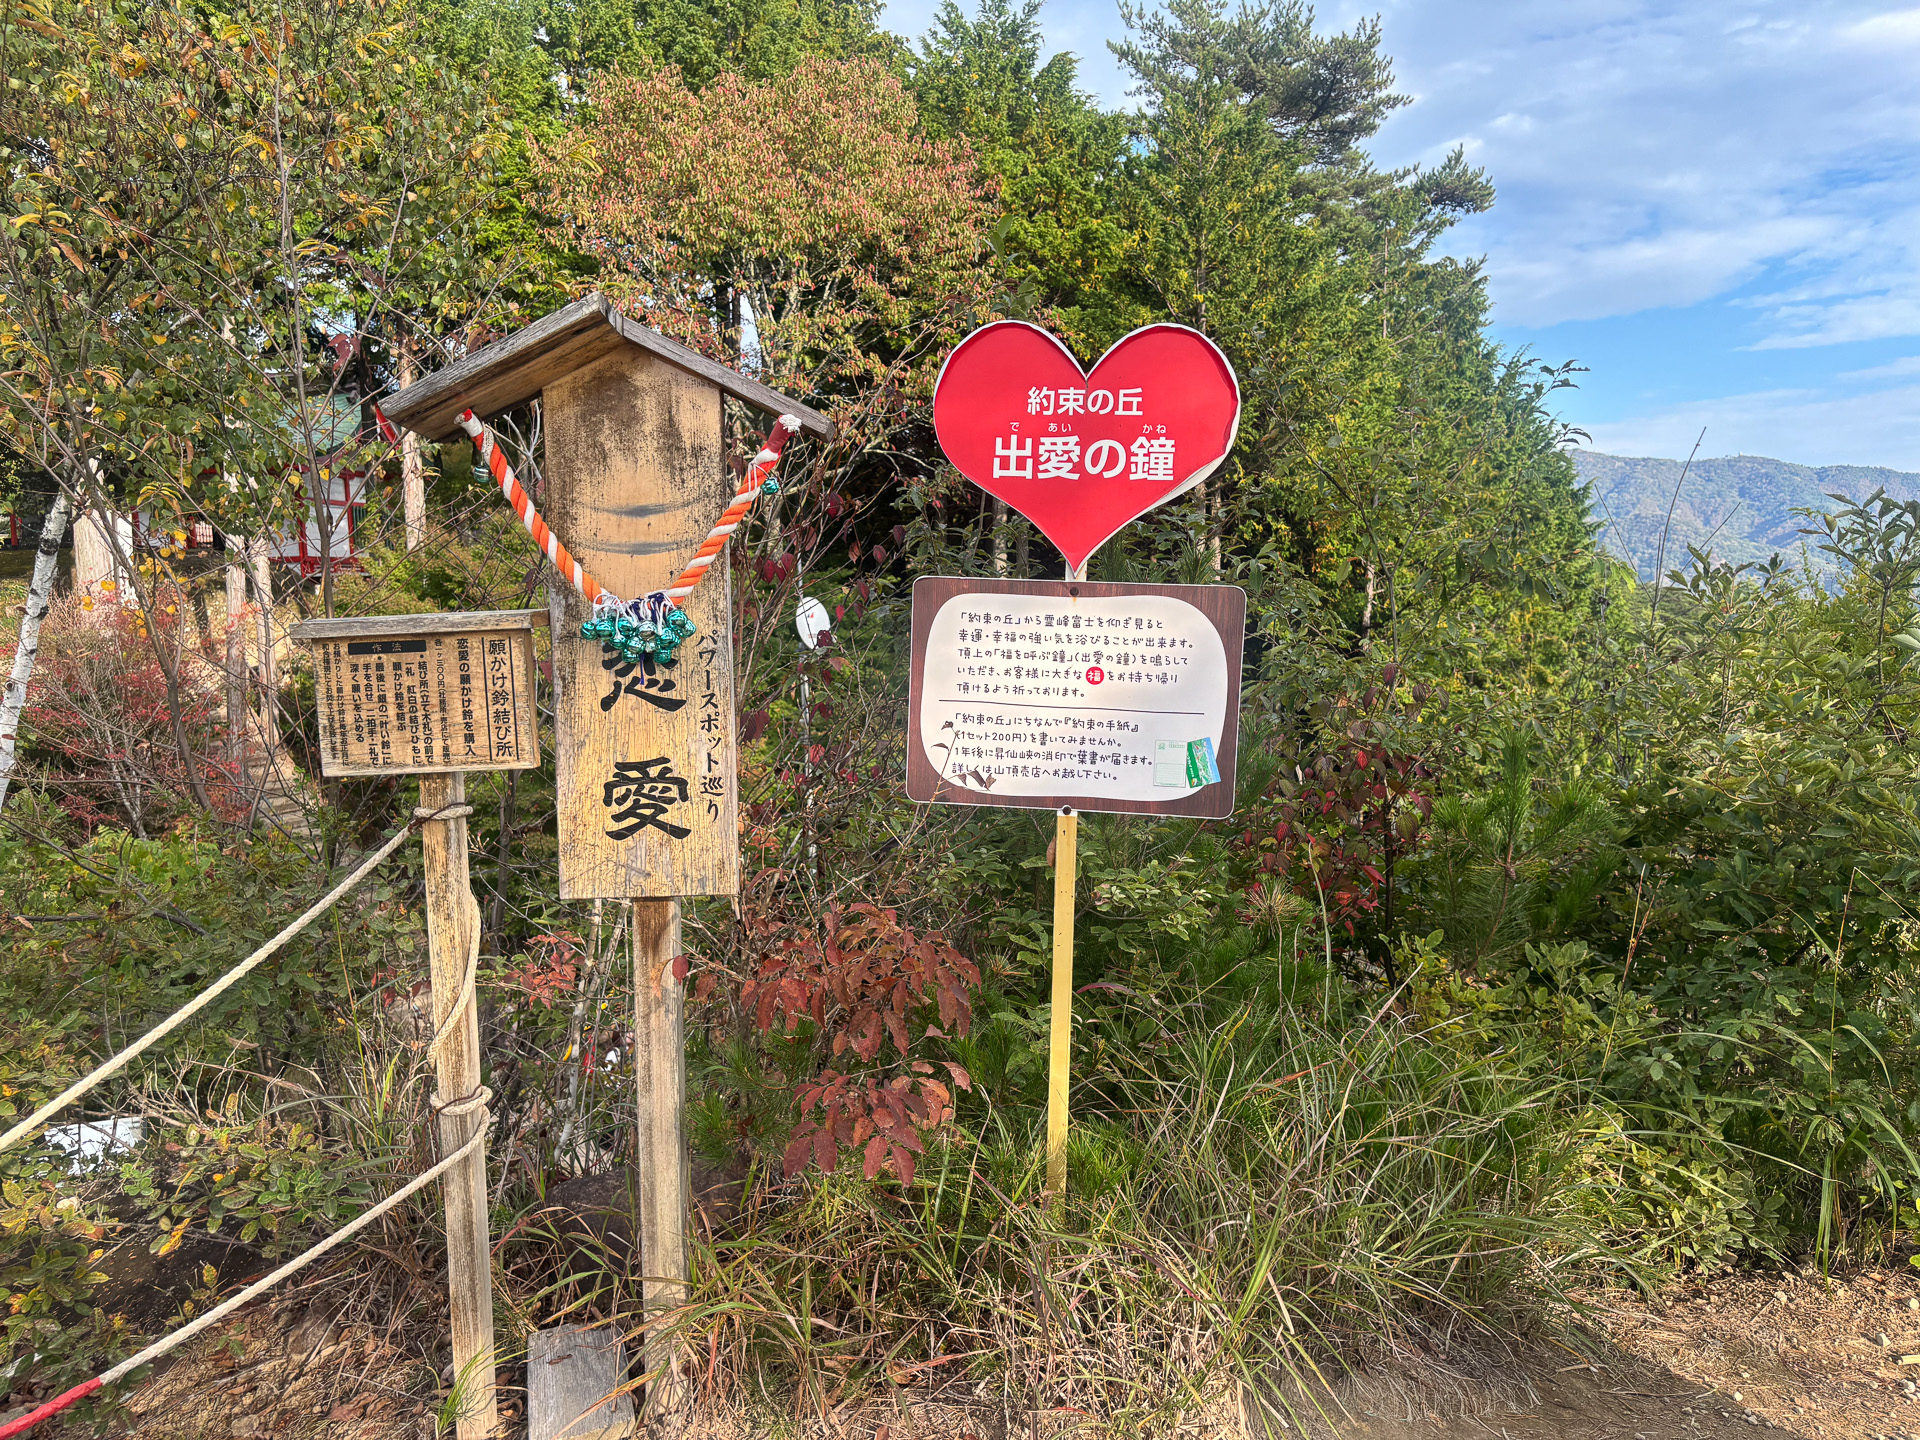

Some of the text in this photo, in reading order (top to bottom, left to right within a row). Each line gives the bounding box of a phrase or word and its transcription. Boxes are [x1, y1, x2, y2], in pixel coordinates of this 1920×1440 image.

[1027, 386, 1143, 416] 約束の丘
[1009, 422, 1167, 434] で あい かね
[992, 434, 1175, 481] 出愛の鐘
[958, 628, 1194, 649] 幸運・幸福の強い気を浴びることが出来ます。
[960, 611, 1164, 630] 「約束の丘」から霊峰富士を仰ぎ見ると
[372, 641, 402, 653] 作法
[350, 663, 365, 743] 深く願いを込める
[392, 661, 407, 732] 願かけ鈴を結ぶ
[456, 638, 477, 756] 恋愛の願かけ鈴を購入
[488, 639, 513, 758] 願かけ鈴結び所
[957, 683, 1086, 698] 頂けるよう祈っております。
[697, 629, 725, 823] パワースポット巡り
